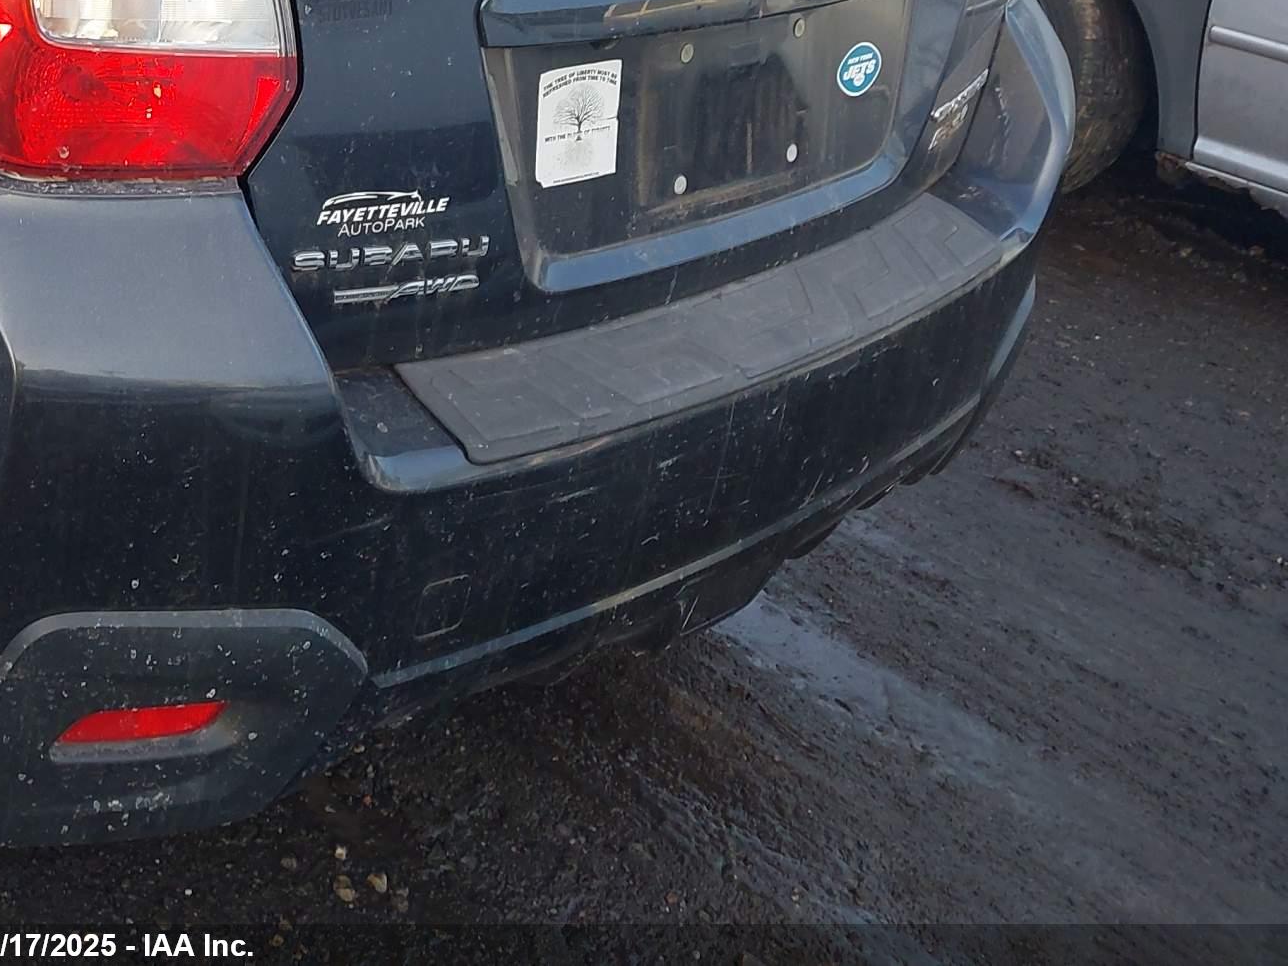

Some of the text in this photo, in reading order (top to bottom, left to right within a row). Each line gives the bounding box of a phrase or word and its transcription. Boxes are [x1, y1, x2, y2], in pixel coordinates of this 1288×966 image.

[554, 74, 568, 85] TREE
[568, 71, 576, 79] OF
[597, 69, 611, 77] MUST
[573, 75, 587, 83] FROM
[842, 59, 877, 81] JETS
[557, 133, 566, 141] THE
[316, 196, 450, 226] FAYETTEVILLE
[294, 235, 490, 271] SUBARU
[389, 275, 480, 299] AWD
